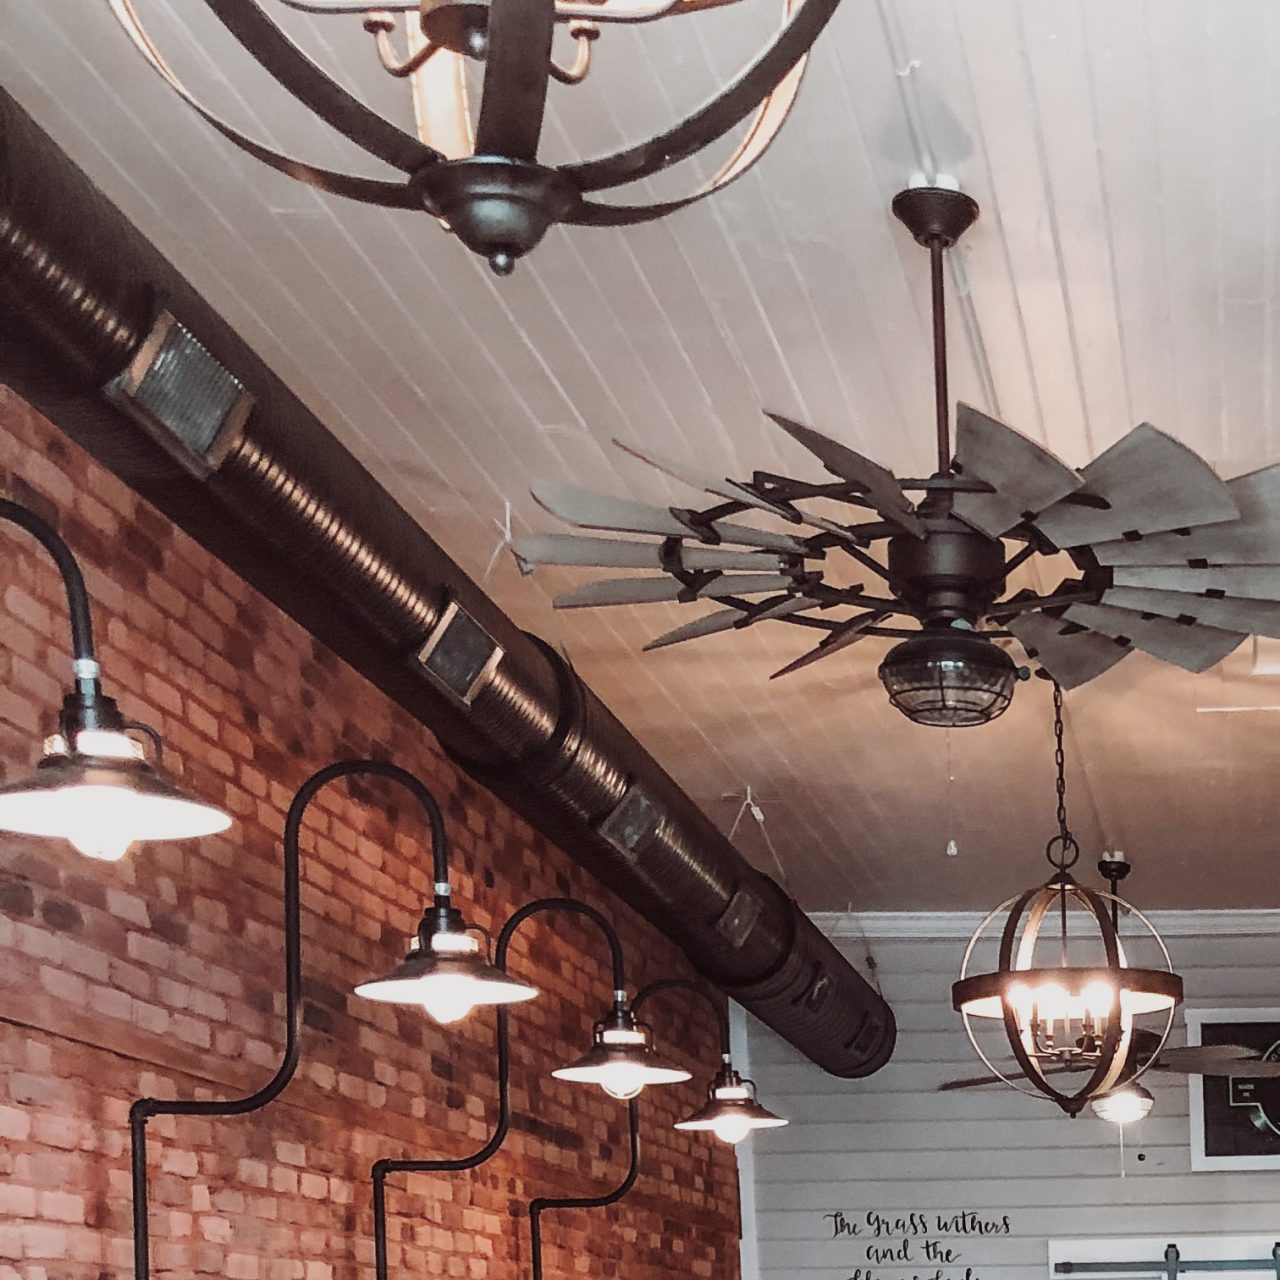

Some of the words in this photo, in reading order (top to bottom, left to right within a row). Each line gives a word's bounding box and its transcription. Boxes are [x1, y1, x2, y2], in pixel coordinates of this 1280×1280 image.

[823, 1211, 862, 1237] The
[866, 1239, 914, 1264] and
[920, 1240, 962, 1264] the
